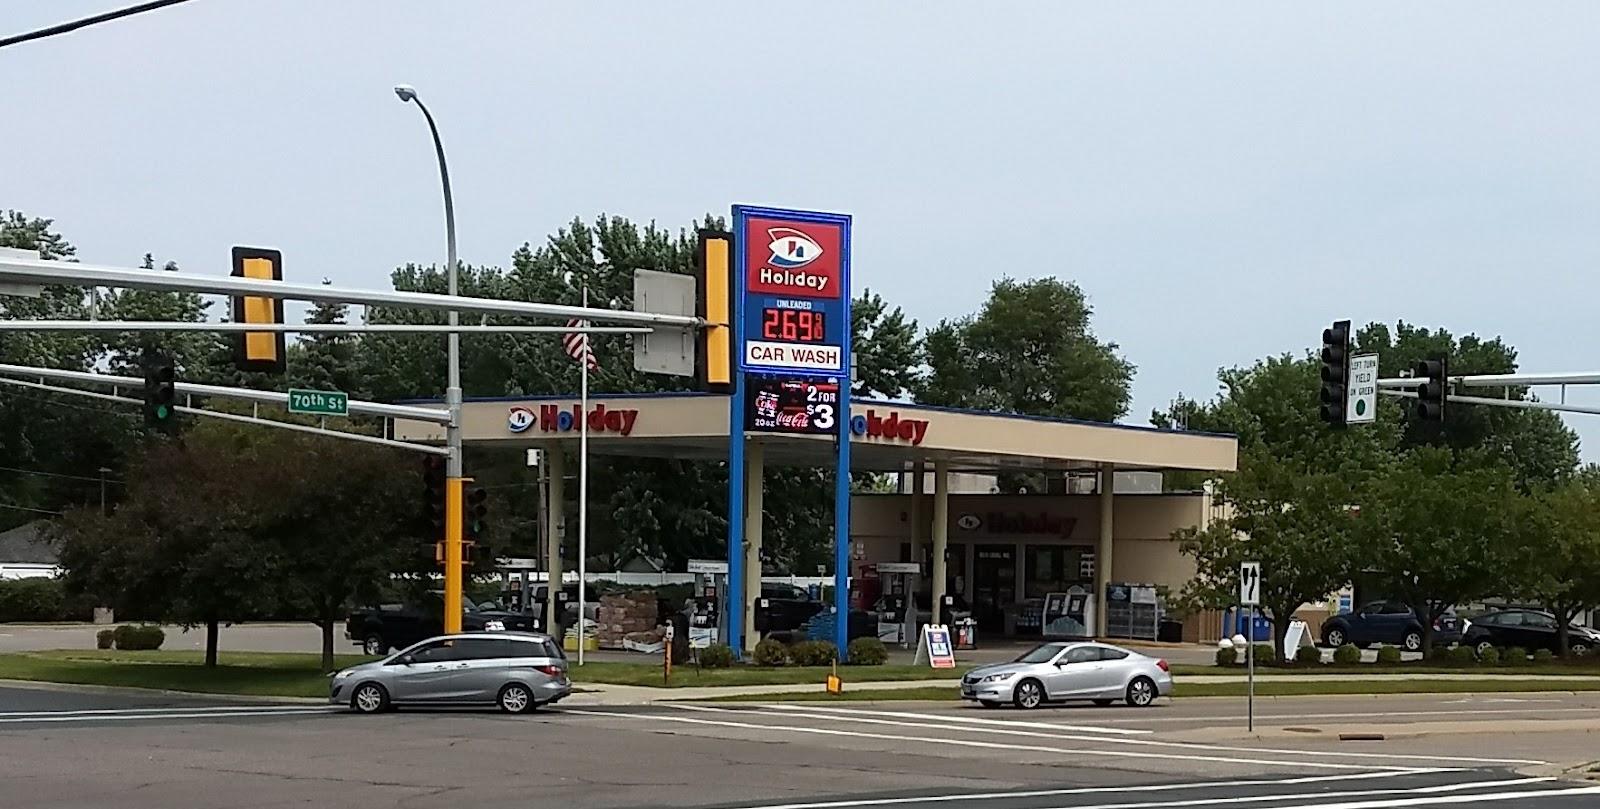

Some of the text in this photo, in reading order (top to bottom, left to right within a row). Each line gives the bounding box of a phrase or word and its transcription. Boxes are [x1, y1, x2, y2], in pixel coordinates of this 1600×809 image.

[760, 268, 828, 290] Holiday
[776, 299, 812, 310] UNLEADED
[751, 346, 837, 364] CAR WASH
[1351, 359, 1376, 370] LEFT TURN
[1355, 373, 1371, 383] YIELD
[807, 385, 817, 402] 2
[818, 392, 836, 402] FOR
[1350, 387, 1374, 396] ON GREEN
[292, 393, 343, 410] 70th St
